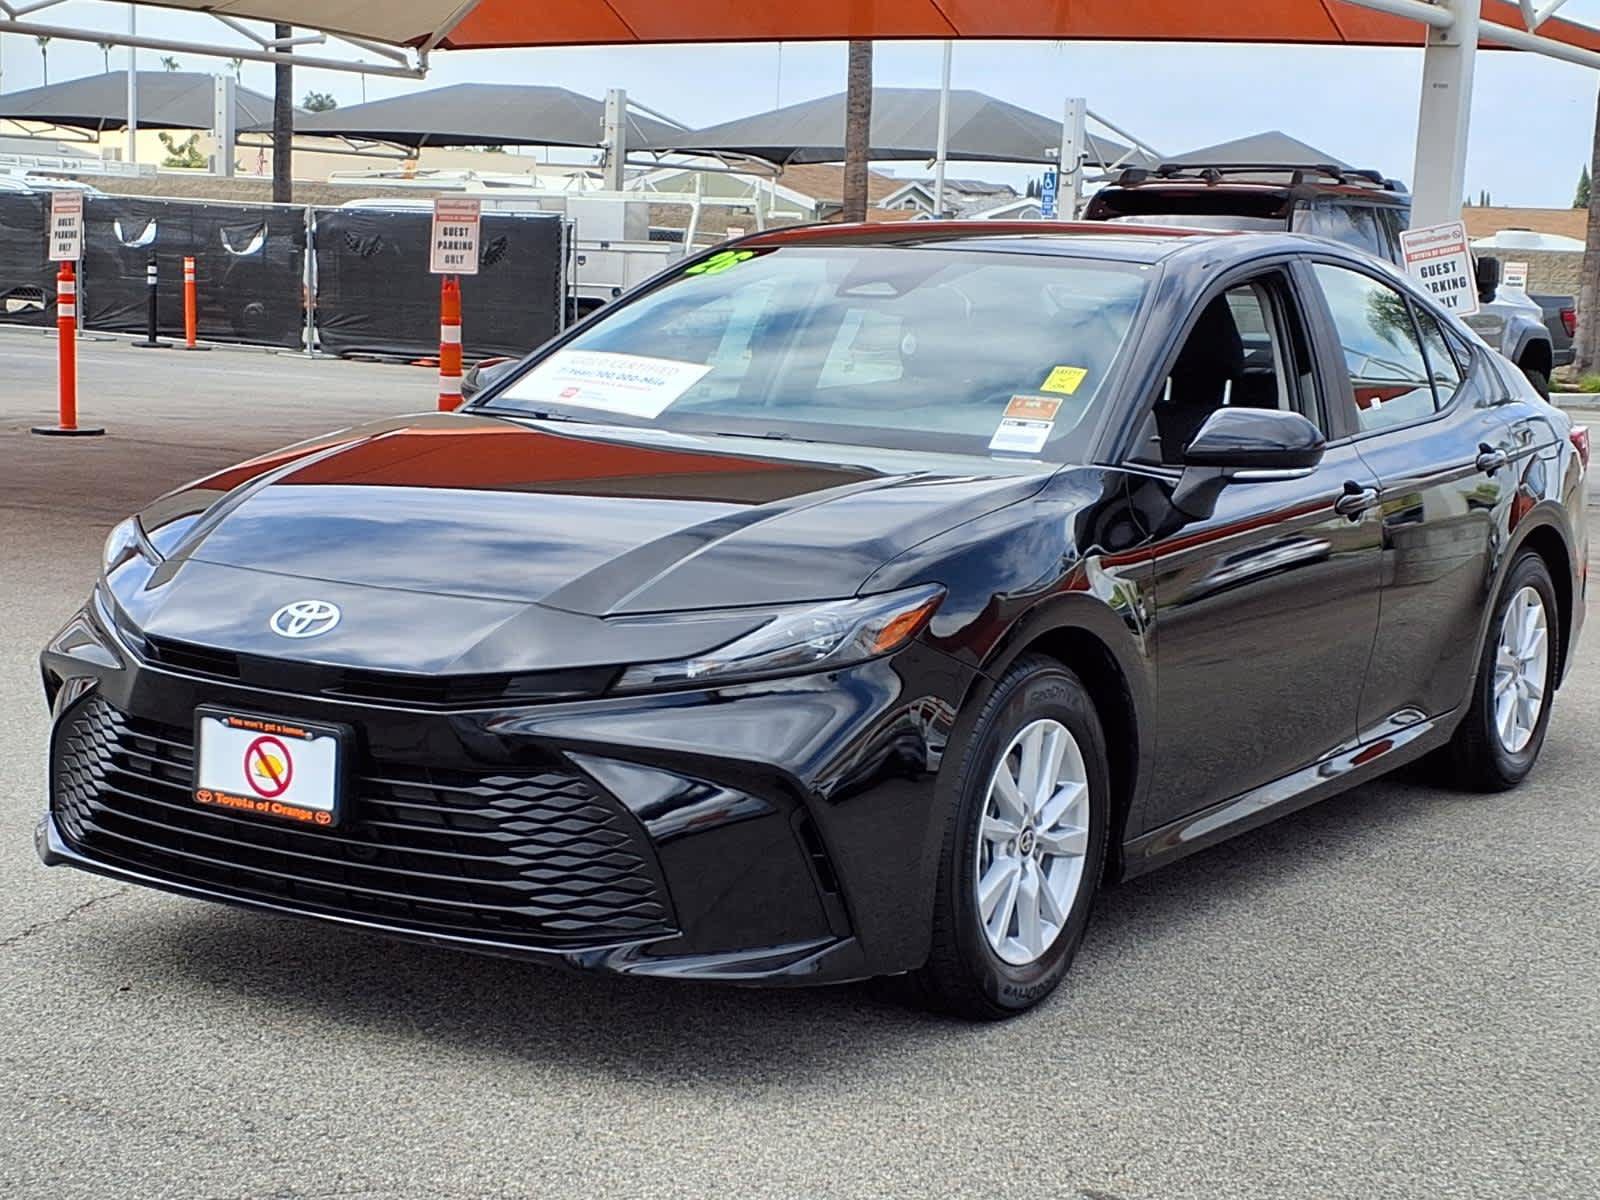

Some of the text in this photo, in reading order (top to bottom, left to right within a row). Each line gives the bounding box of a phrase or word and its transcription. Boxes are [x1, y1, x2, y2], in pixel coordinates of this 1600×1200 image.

[443, 227, 469, 237] GUEST
[437, 241, 473, 251] PARKING
[444, 255, 464, 264] ONLY
[1420, 261, 1457, 278] GUEST
[264, 723, 276, 732] get
[214, 792, 313, 820] Toyota of Orange
